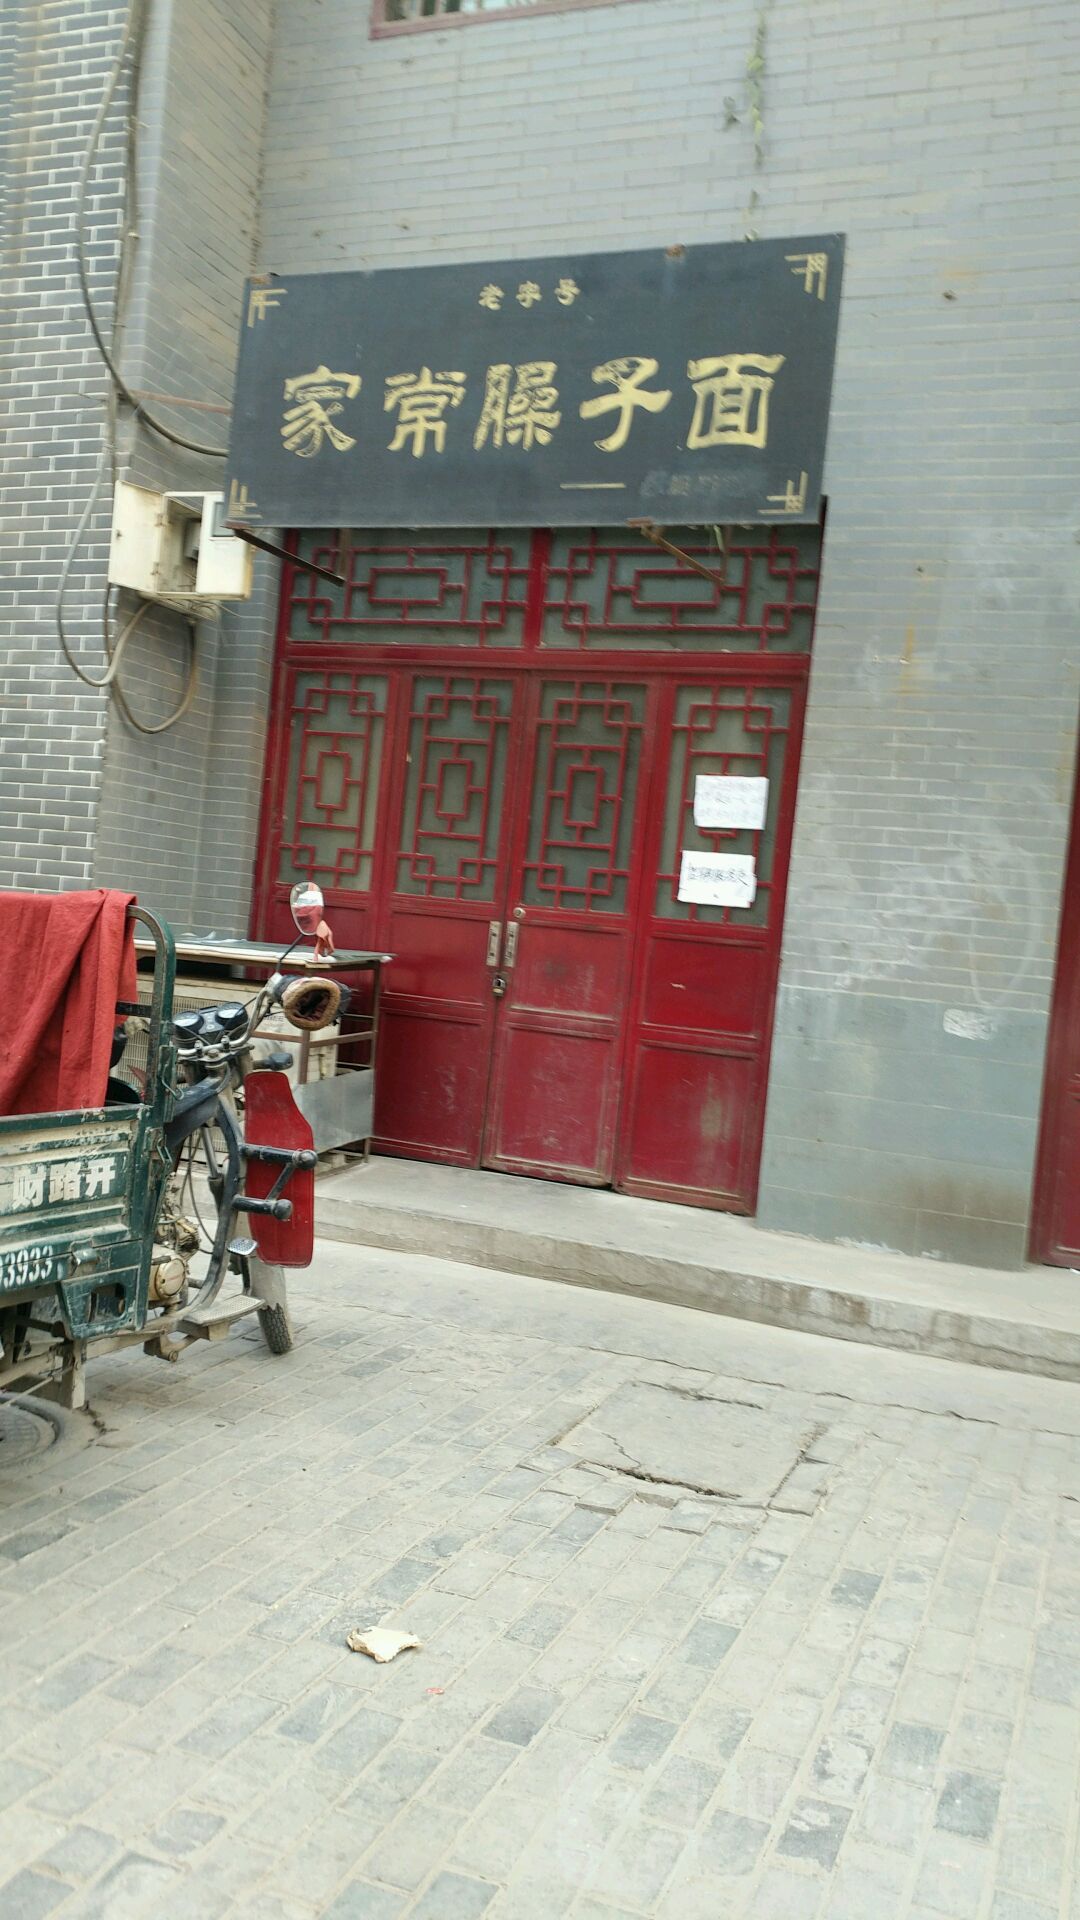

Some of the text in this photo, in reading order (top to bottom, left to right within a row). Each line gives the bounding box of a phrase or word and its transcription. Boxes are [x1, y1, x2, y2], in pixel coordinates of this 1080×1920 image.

[478, 278, 581, 310] 老字号
[280, 353, 786, 459] 家常臊子面
